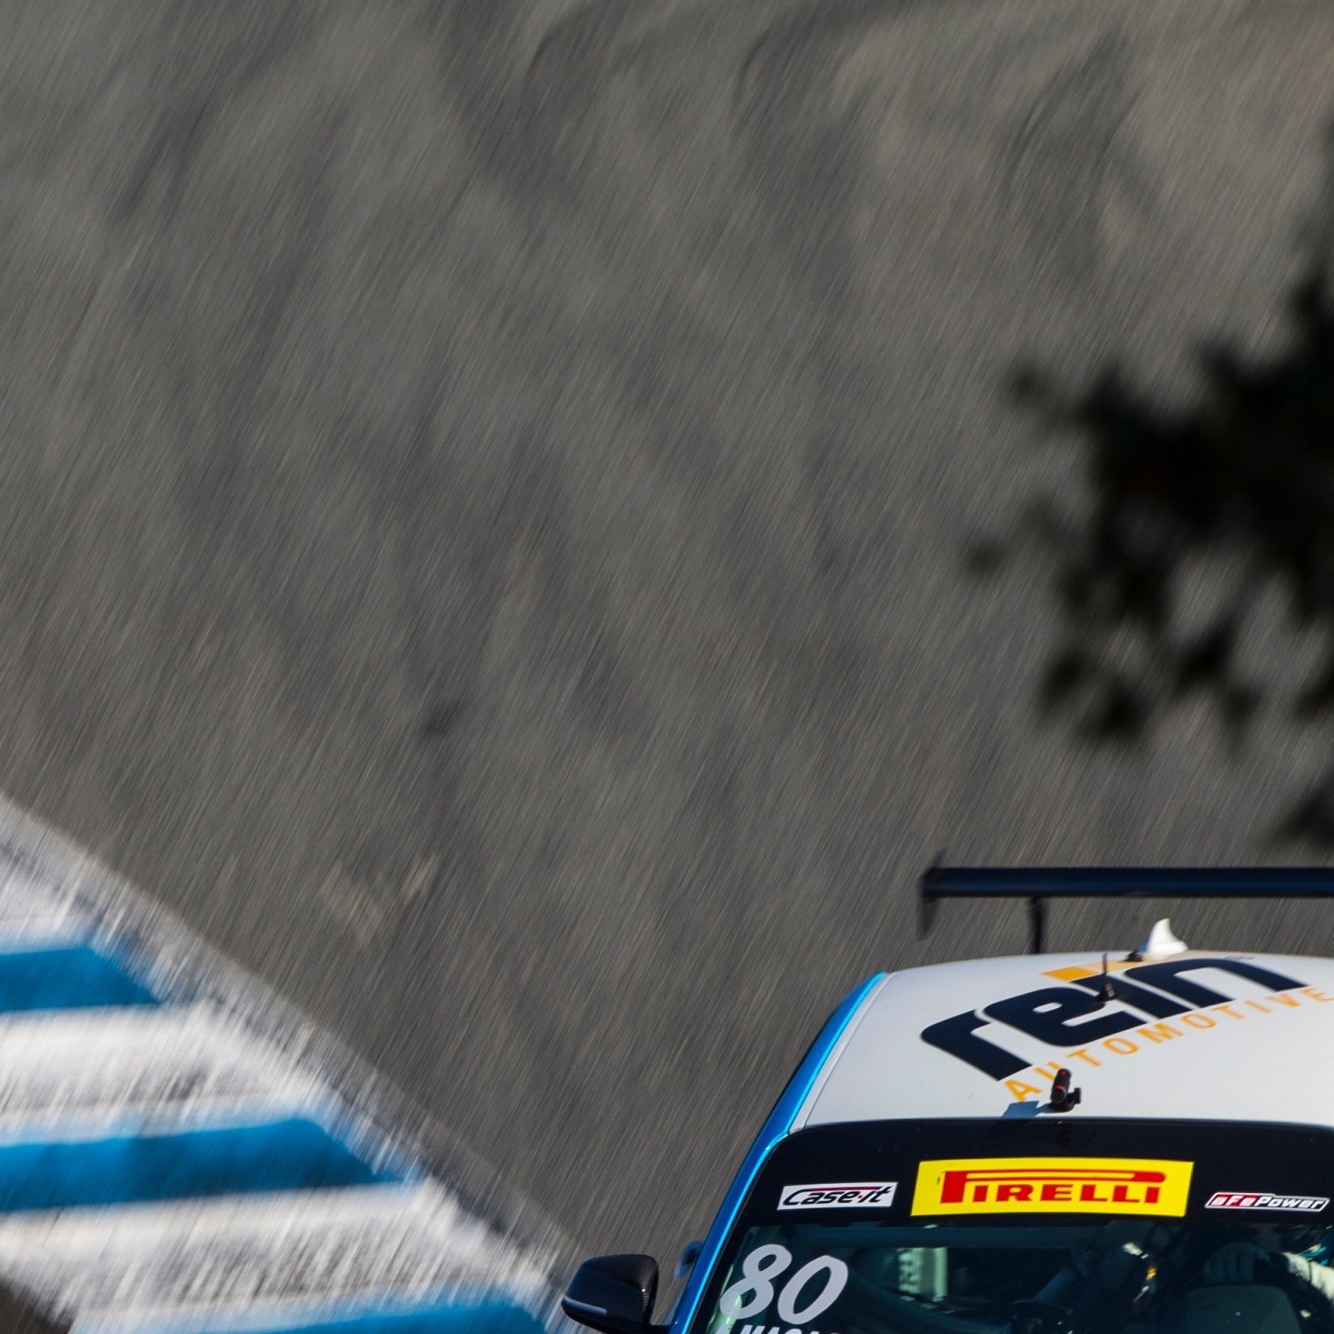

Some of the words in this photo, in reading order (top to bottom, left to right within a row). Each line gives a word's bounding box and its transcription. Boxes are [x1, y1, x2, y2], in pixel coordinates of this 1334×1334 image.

[920, 959, 1310, 1081] rein
[940, 1168, 1166, 1204] PIRELLI
[719, 1243, 848, 1325] 80
